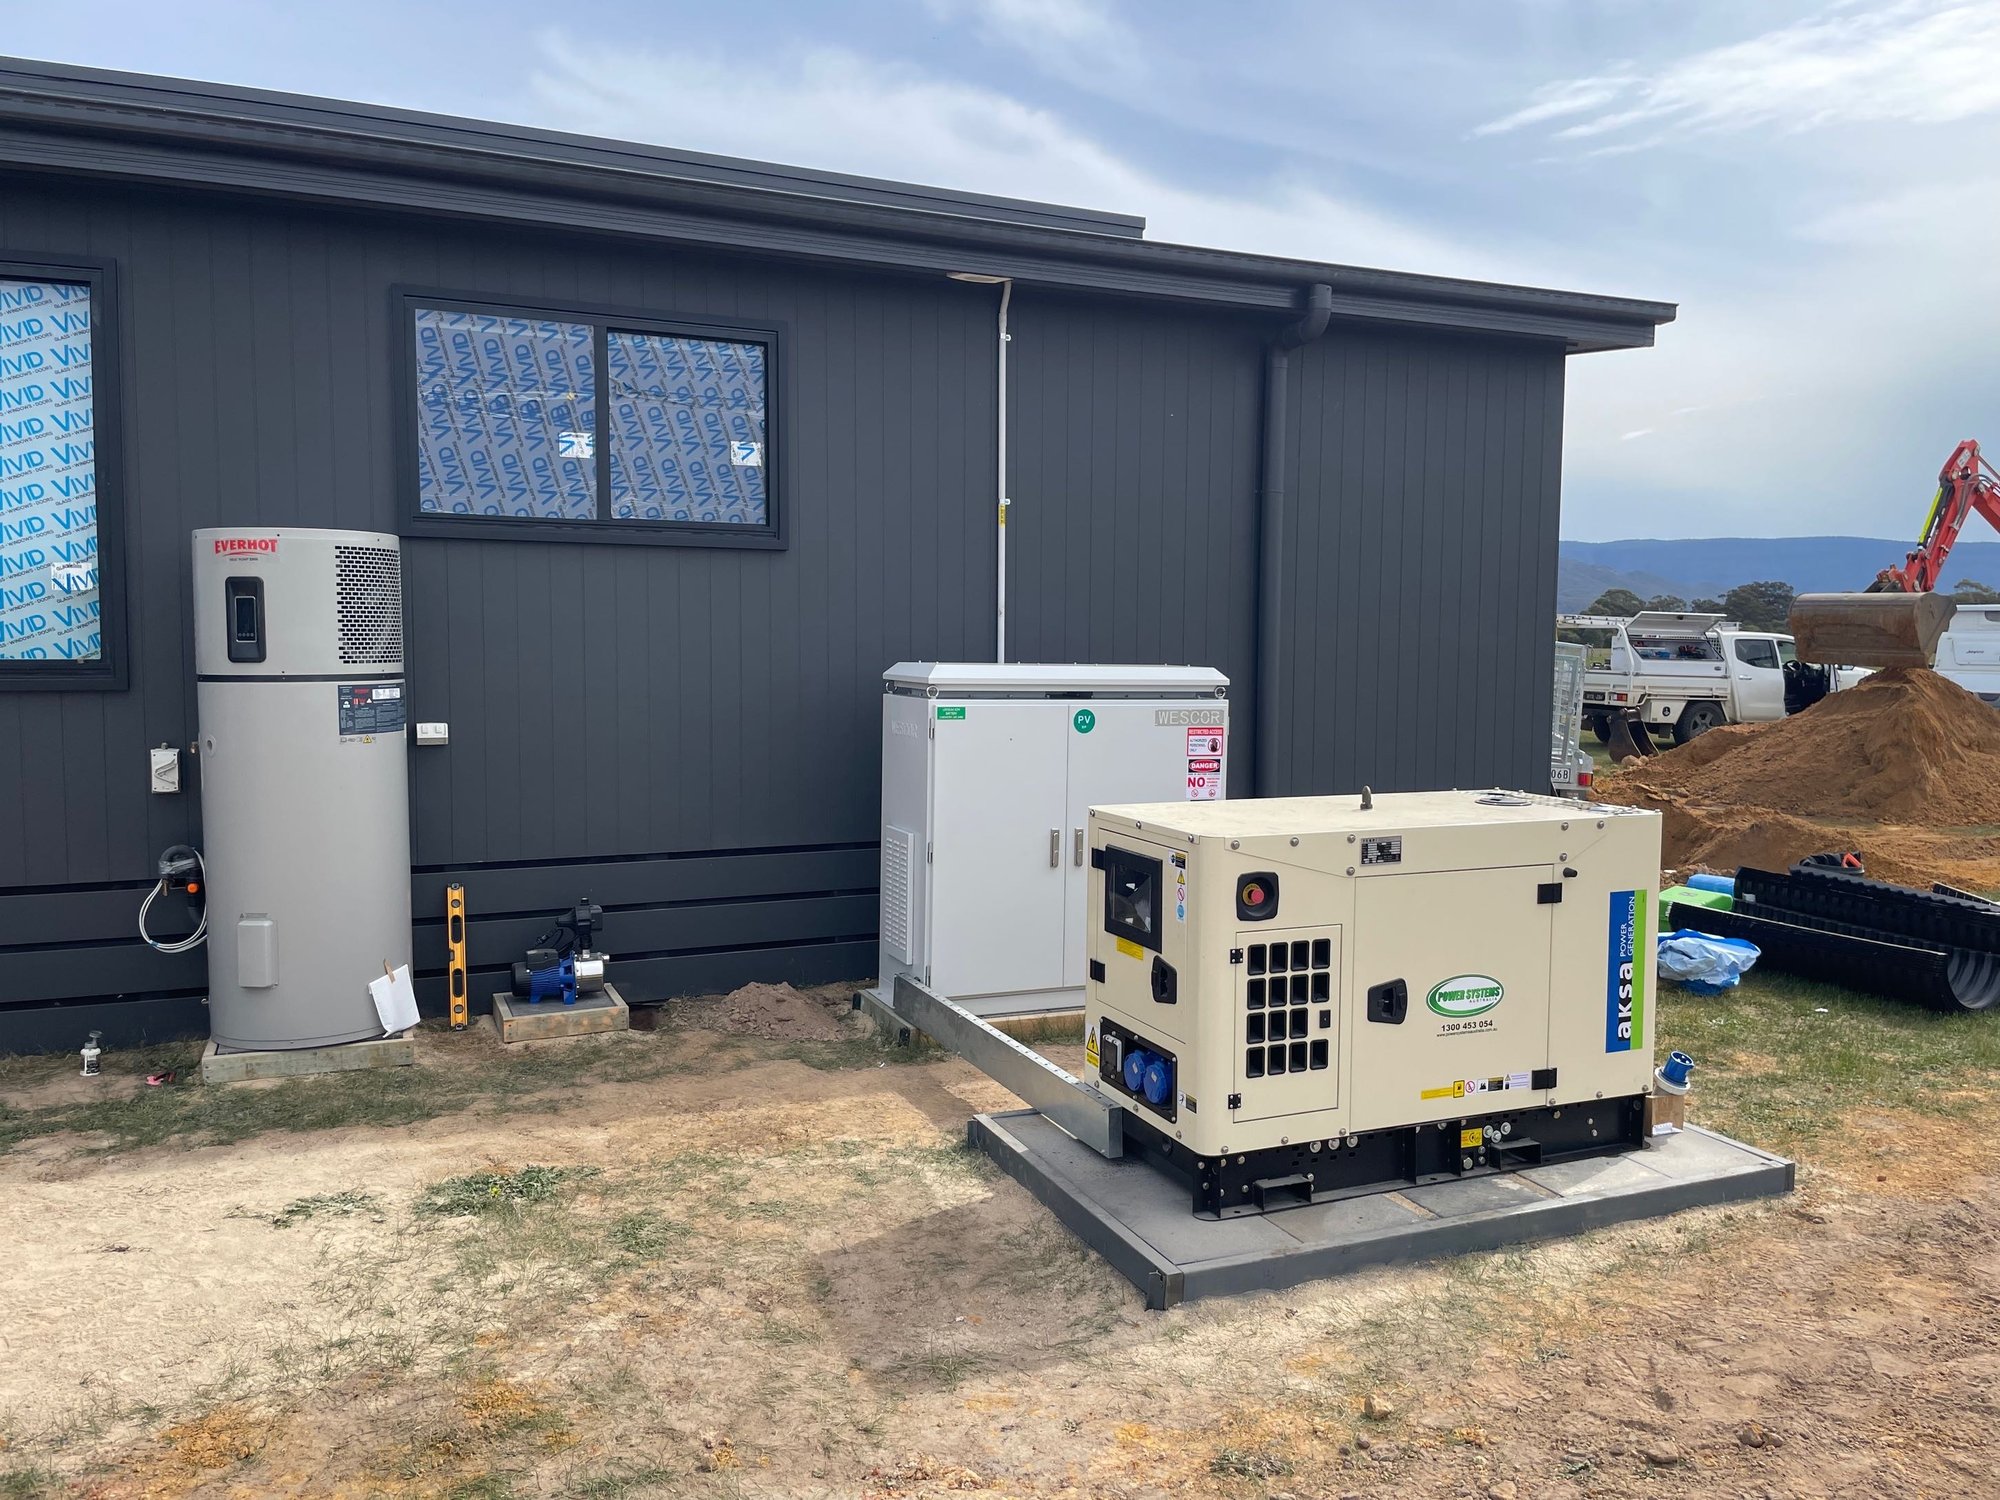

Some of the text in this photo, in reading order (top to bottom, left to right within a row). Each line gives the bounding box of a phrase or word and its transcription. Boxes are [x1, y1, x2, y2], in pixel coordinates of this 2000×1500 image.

[0, 286, 43, 310] IVID
[6, 299, 52, 314] WINDOWS DOORS
[54, 301, 69, 309] GLASS
[0, 318, 44, 344] IVID
[6, 332, 52, 348] WINDOWS DOORS
[0, 352, 44, 377] IVID
[50, 343, 91, 366] VIV
[452, 333, 477, 389] VIVID
[484, 339, 508, 393] VIVID
[7, 366, 52, 380] WINDOWS DOORS
[515, 344, 539, 392] VIVID
[546, 350, 569, 397] VIVID
[0, 385, 44, 410] IVID
[50, 375, 91, 398] VIV
[7, 398, 52, 414] WINDOWS DOORS
[55, 400, 71, 408] GLASS
[0, 418, 45, 444] IVID
[7, 431, 53, 447] WINDOWS DOORS
[619, 404, 644, 451] VIVID
[647, 406, 672, 453] VIVID
[676, 410, 700, 456] VIVID
[704, 412, 727, 458] VIVID
[732, 416, 755, 461] VIVID
[0, 451, 45, 477] IVID
[7, 464, 53, 480] WINDOWS DOORS
[439, 447, 465, 496] VIVID
[471, 451, 496, 499] VIVID
[502, 454, 527, 502] VIVID
[533, 457, 558, 505] VIVID
[562, 461, 588, 507] VIVID
[633, 456, 657, 501] VIVID
[661, 458, 685, 505] VIVID
[689, 461, 713, 507] VIVID
[717, 464, 739, 509] VIVID
[0, 484, 45, 510] IVID
[8, 497, 53, 513] WINDOWS DOORS
[55, 498, 71, 506] GLASS
[0, 517, 46, 544] IVID
[51, 505, 96, 530] VIVI
[8, 530, 54, 546] WINDOWS DOORS
[214, 539, 278, 554] EVERHOT
[0, 550, 46, 577] IVID
[8, 562, 55, 579] WINDOWS DOORS
[0, 582, 47, 609] IVID
[9, 595, 55, 611] WINDOWS DOORS
[0, 614, 47, 642] IVID
[9, 627, 55, 645] WINDOWS DOORS
[57, 628, 74, 636] GLASS
[1078, 715, 1091, 724] PV
[1158, 711, 1220, 724] WESCOR
[1187, 777, 1205, 787] NO
[1627, 896, 1635, 956] GENERATION
[1619, 923, 1627, 957] POWER
[1438, 986, 1500, 1002] POWER SYSTEMS
[1617, 962, 1633, 1039] aksa
[1441, 1019, 1493, 1031] 1300 453 054
